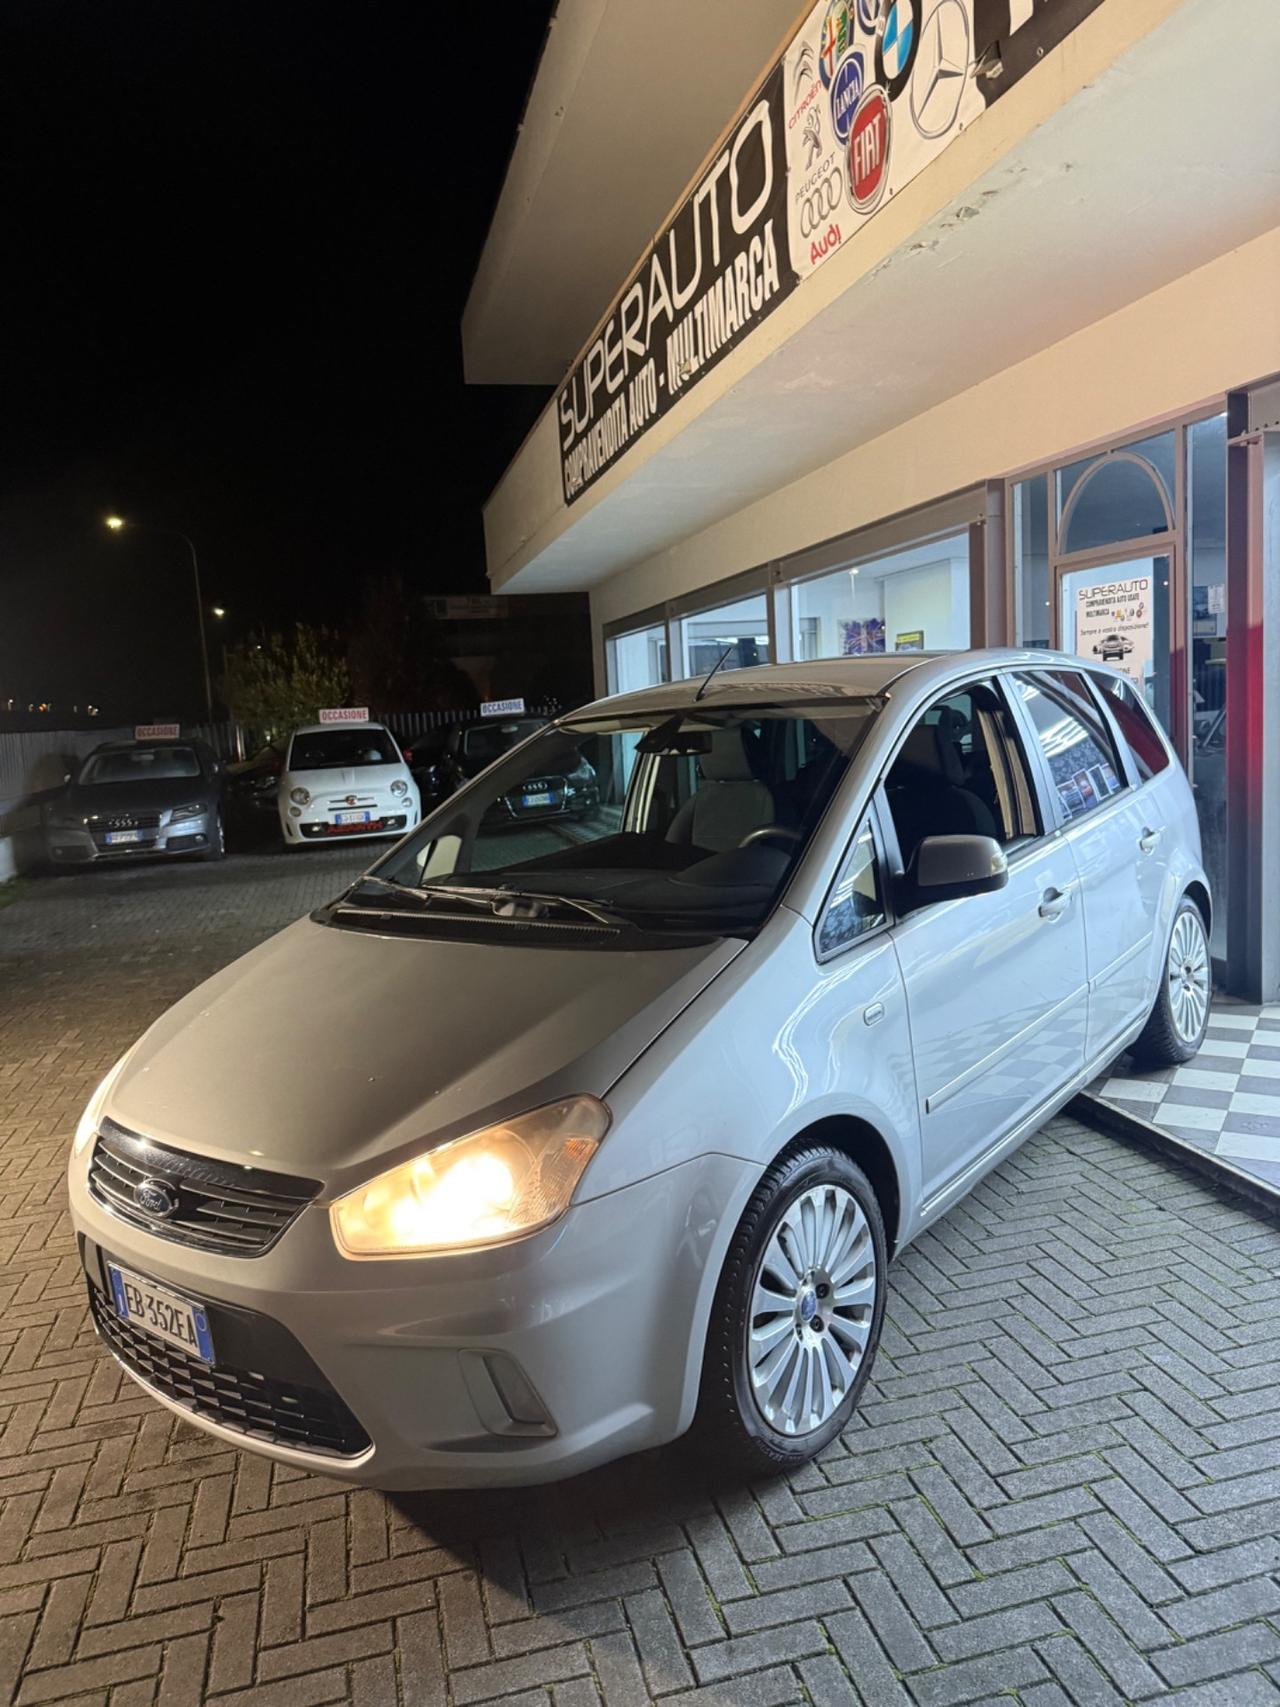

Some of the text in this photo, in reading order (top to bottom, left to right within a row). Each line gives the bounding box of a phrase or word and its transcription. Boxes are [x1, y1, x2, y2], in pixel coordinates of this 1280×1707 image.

[854, 111, 881, 187] FIAT
[795, 151, 836, 205] PEUGEOT
[810, 223, 842, 265] Audi
[560, 99, 774, 452] SUPERAUTO
[628, 356, 658, 436] AUTO
[666, 217, 781, 396] MULTIMARCA
[1079, 578, 1149, 601] SUPERAUTO
[322, 709, 367, 721] OCCASIONE
[482, 700, 523, 714] OCCASIONE
[137, 725, 179, 739] OCCASIONE
[140, 1189, 162, 1210] Ford
